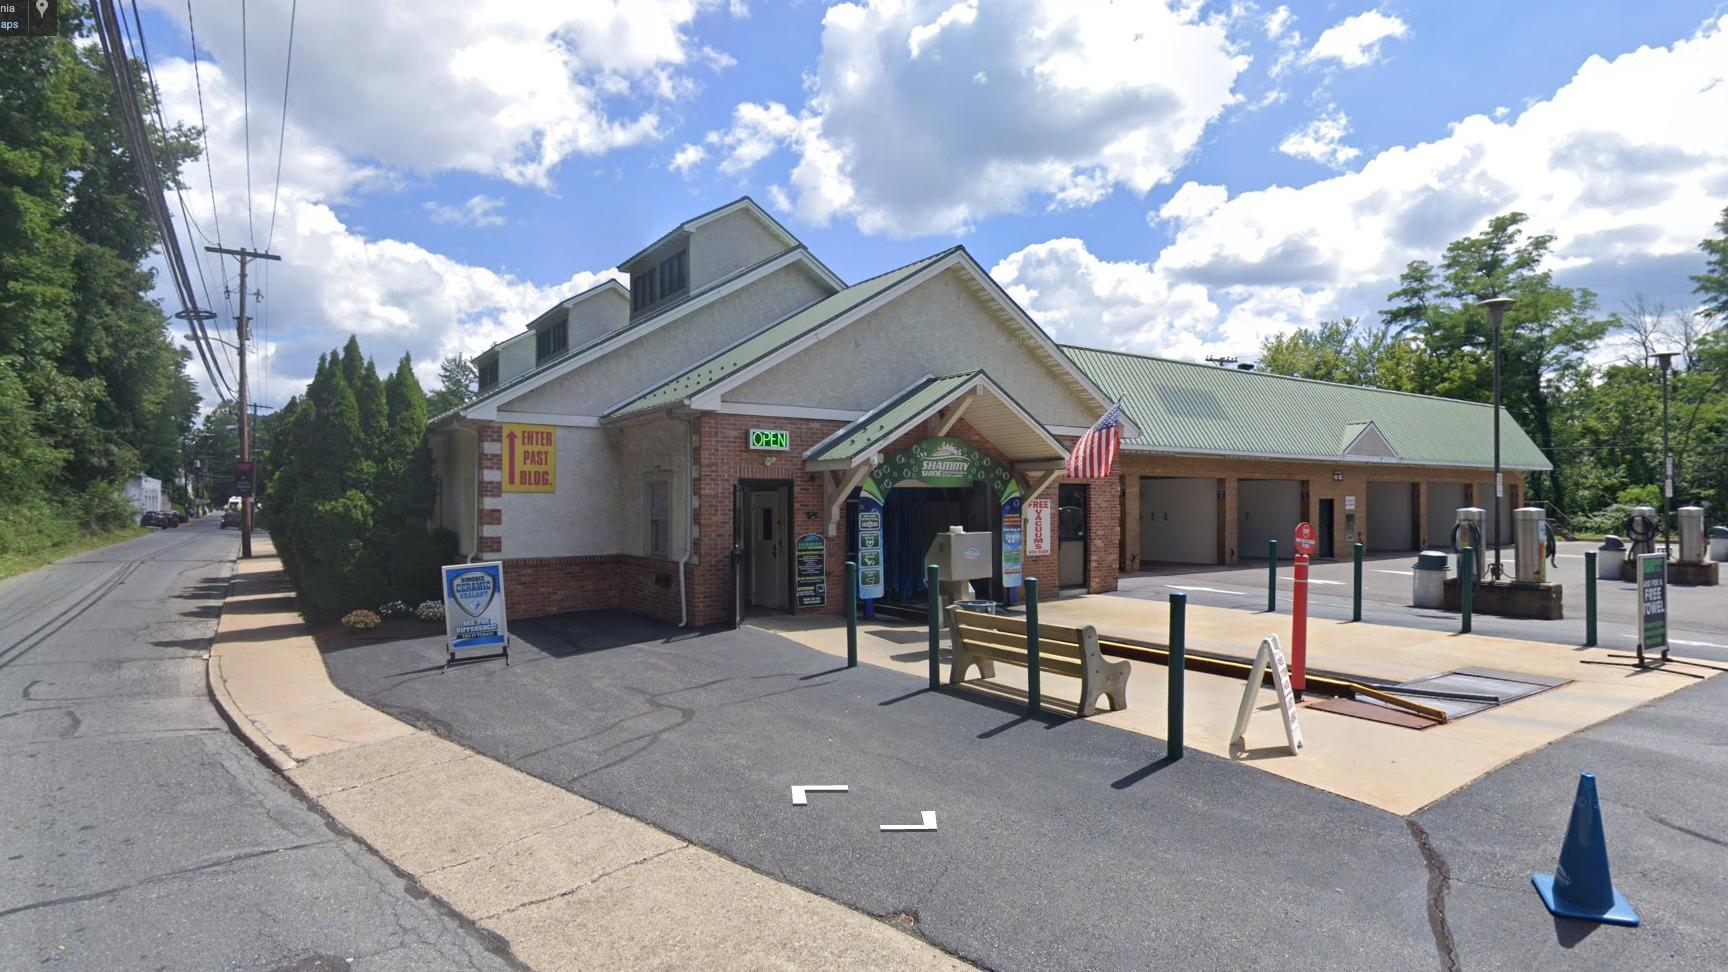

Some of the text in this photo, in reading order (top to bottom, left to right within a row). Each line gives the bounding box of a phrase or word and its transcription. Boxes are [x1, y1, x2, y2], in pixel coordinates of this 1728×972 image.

[521, 430, 553, 447] ENTER
[753, 431, 786, 448] OPEN
[523, 450, 550, 467] PAST
[921, 460, 970, 471] SHAMMY
[1028, 500, 1049, 509] FREE
[1034, 510, 1044, 550] VACUUMS
[456, 581, 491, 593] CERAMIC
[1644, 586, 1662, 602] FREE
